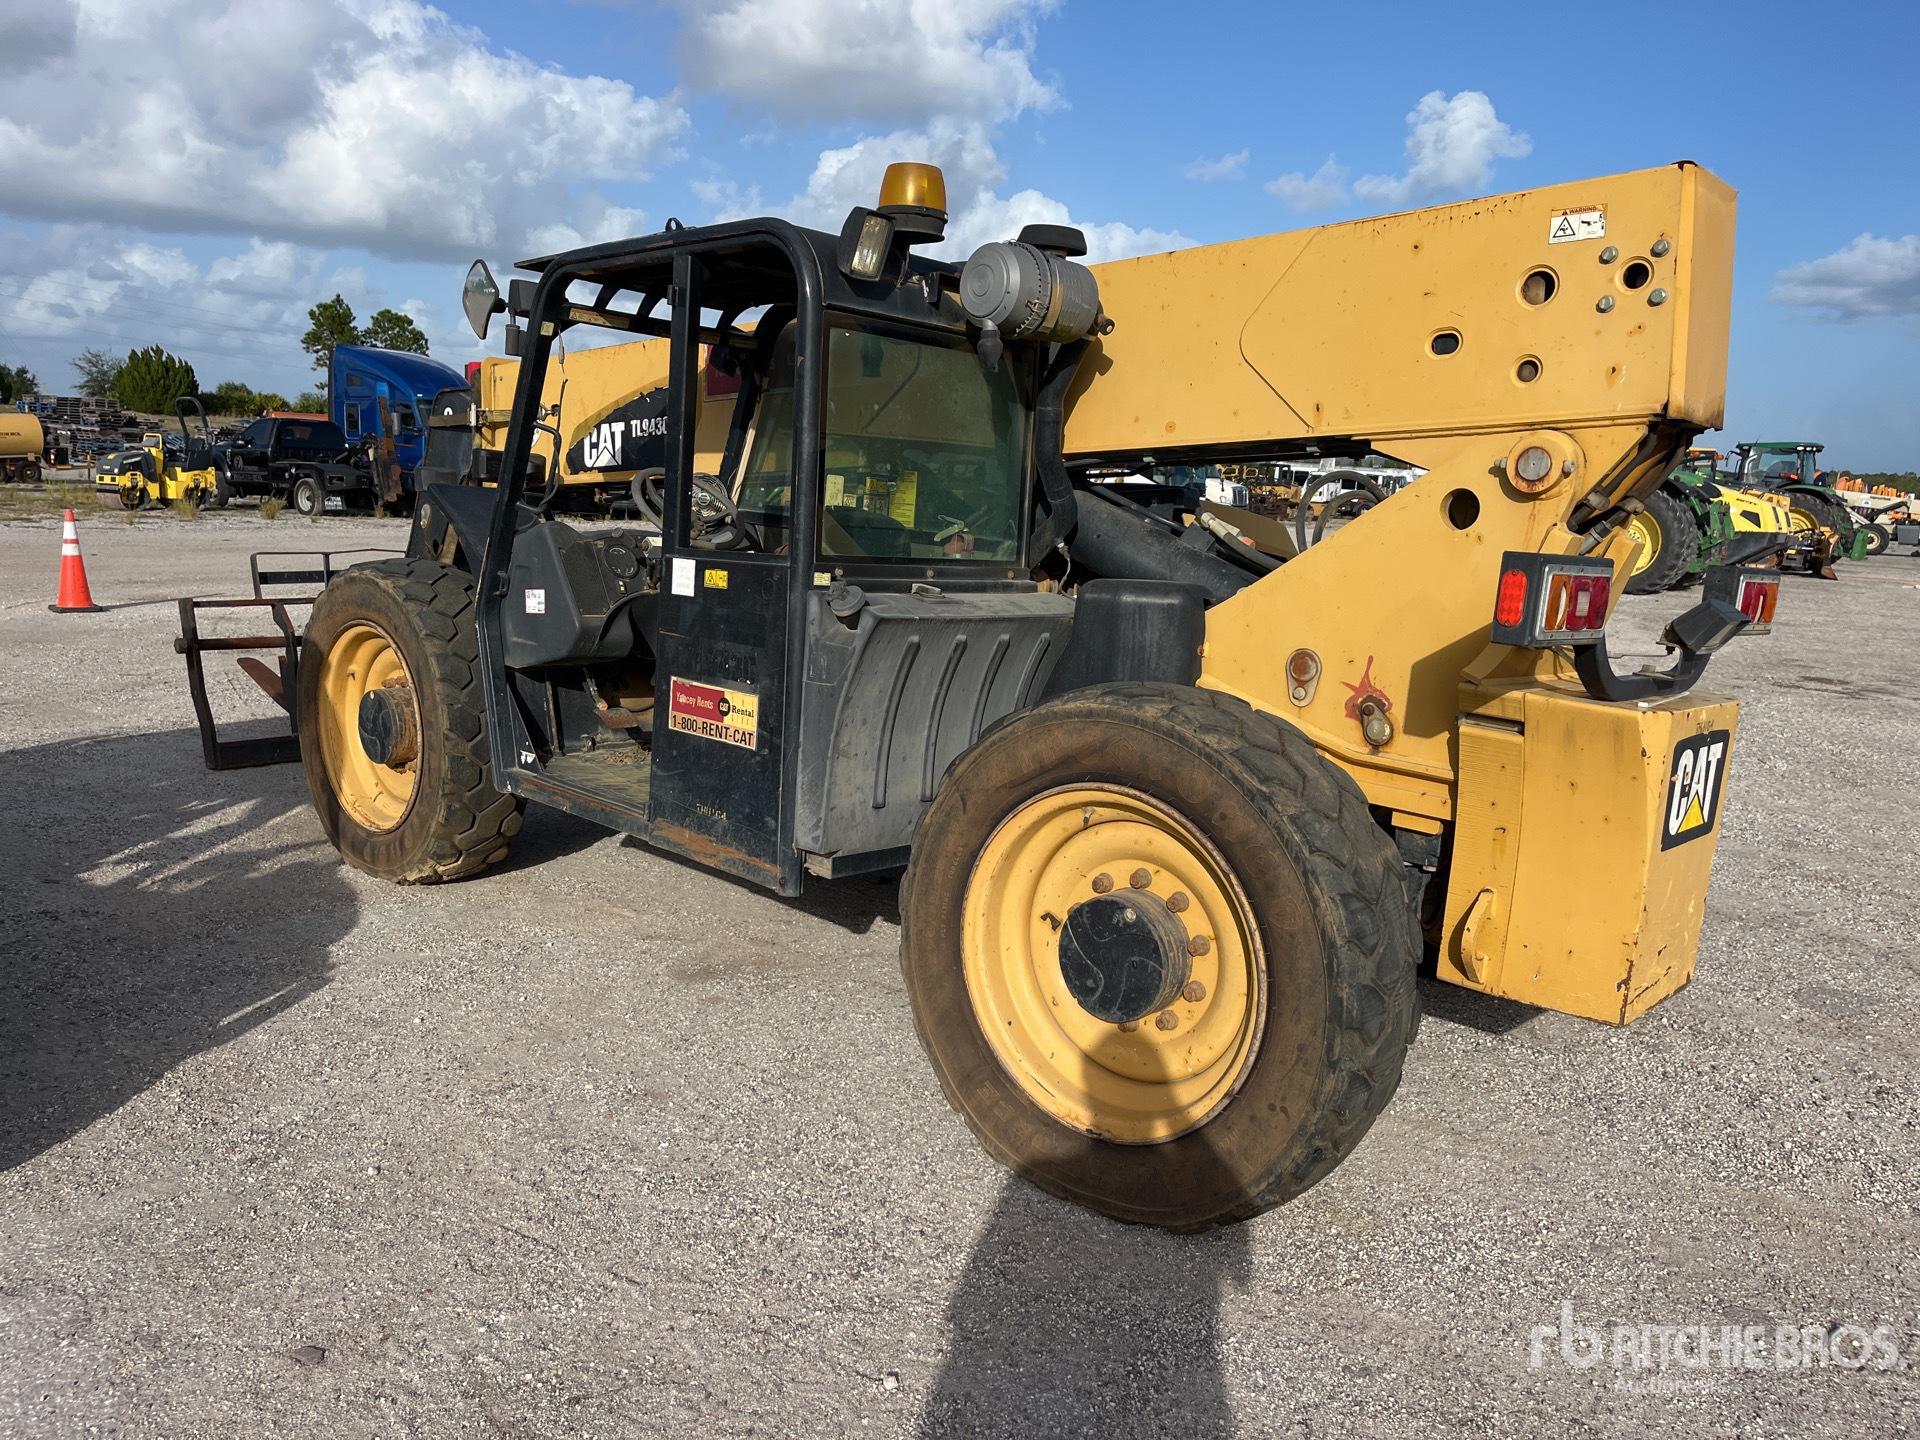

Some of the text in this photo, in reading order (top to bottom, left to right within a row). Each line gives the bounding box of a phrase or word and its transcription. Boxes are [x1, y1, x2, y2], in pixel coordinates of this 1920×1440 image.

[1569, 205, 1597, 214] WARNING
[583, 421, 625, 468] CAT
[697, 696, 714, 710] Rents
[719, 702, 729, 712] CAT
[731, 705, 754, 718] Rental
[672, 714, 754, 747] 1-800-RENT-CAT
[1668, 742, 1723, 835] CAT
